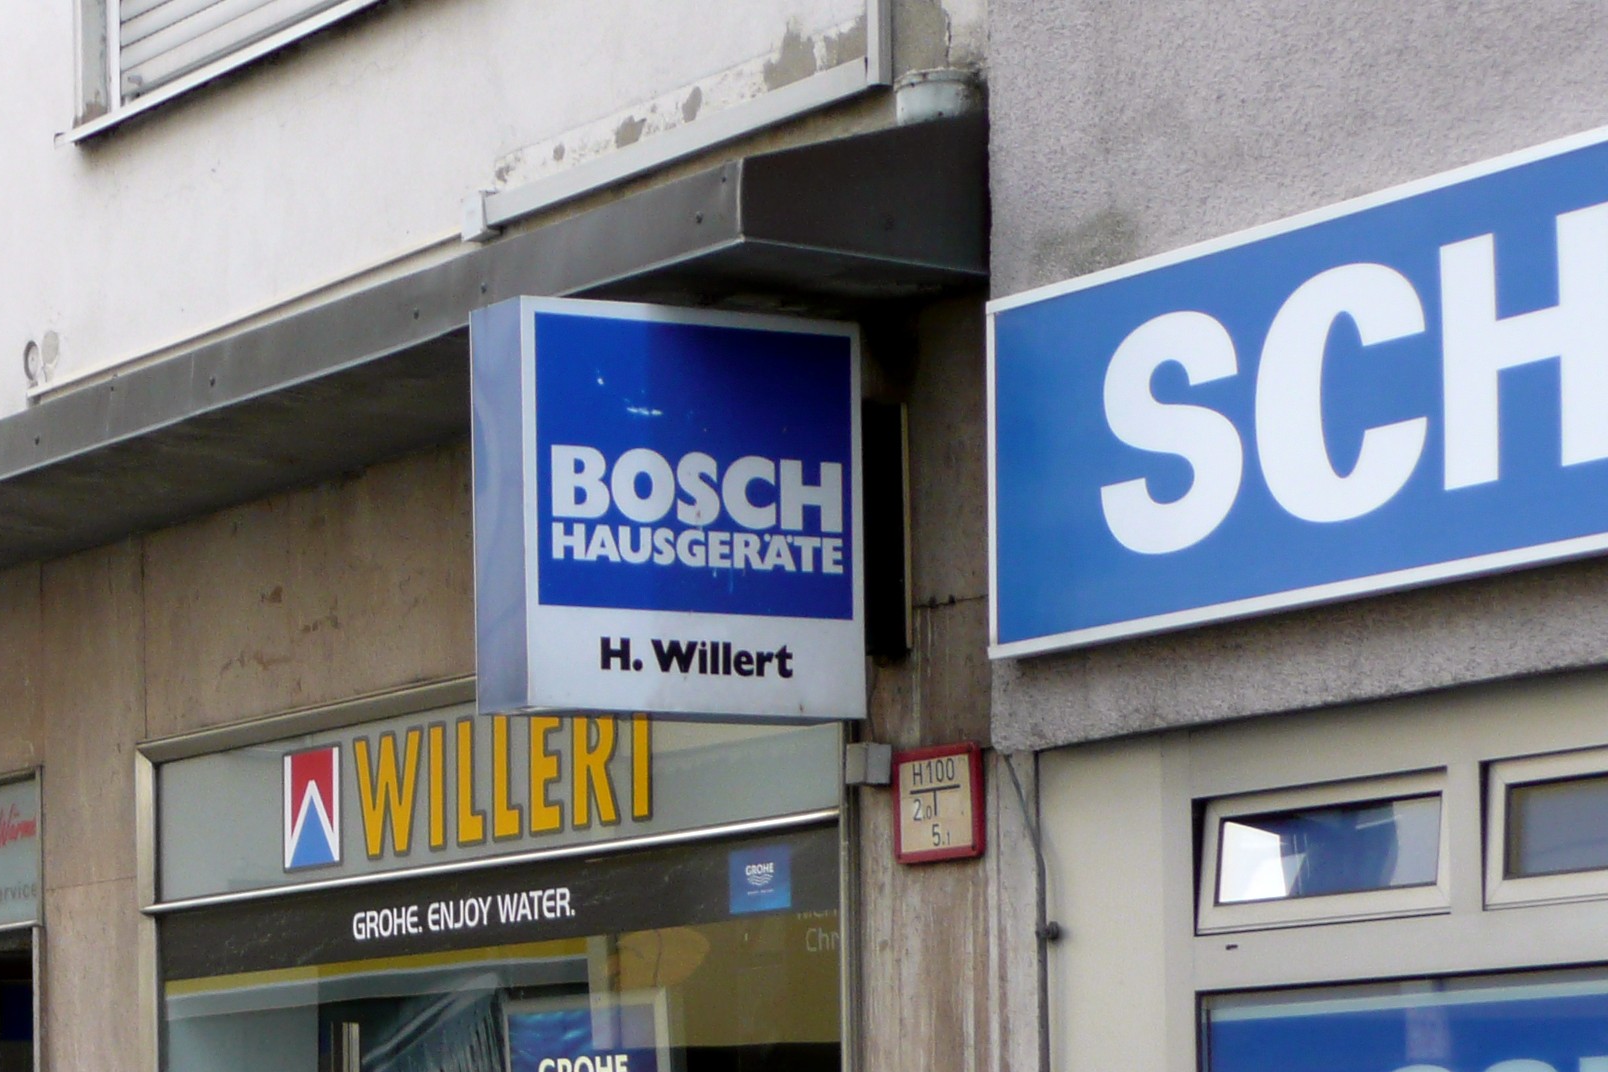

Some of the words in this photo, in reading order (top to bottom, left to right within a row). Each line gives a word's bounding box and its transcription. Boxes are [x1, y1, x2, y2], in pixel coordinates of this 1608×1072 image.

[1100, 200, 1608, 555] SCH
[551, 444, 843, 532] BOSCH
[551, 523, 843, 575] HAUSGERÄTE
[600, 637, 643, 672] H.
[652, 639, 793, 679] Willert
[932, 823, 950, 847] 5.1
[745, 862, 774, 876] GROHE
[352, 905, 423, 941] GROHE.
[427, 898, 491, 931] ENJOY
[496, 887, 576, 924] WATER.
